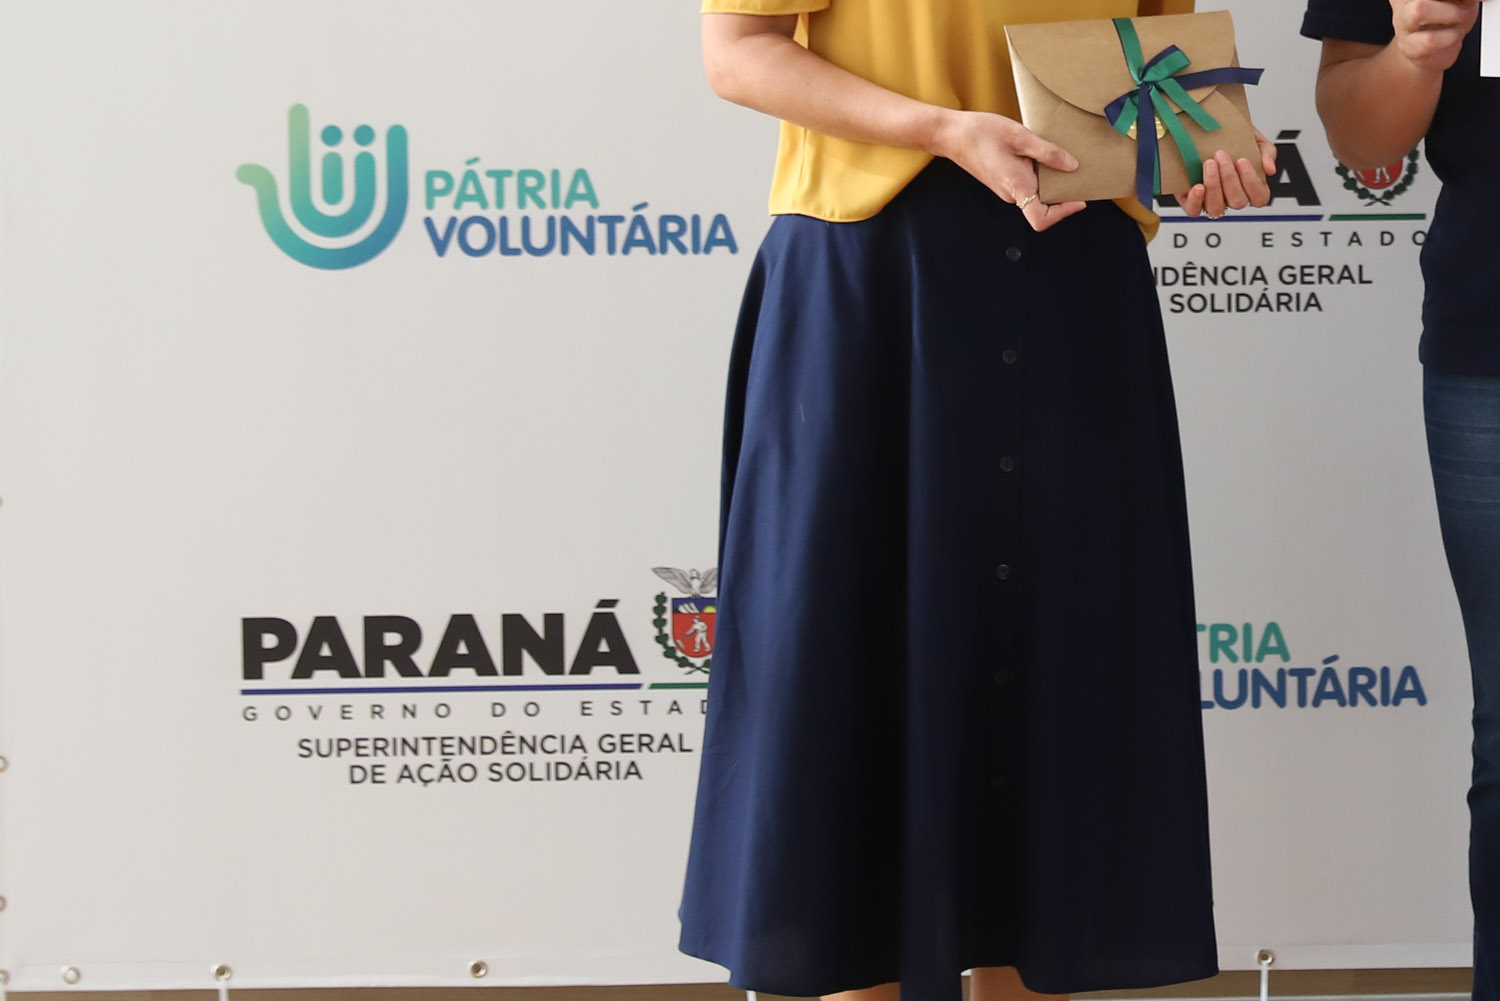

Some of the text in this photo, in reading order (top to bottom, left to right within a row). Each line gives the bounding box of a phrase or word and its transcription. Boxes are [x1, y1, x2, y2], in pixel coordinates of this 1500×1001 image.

[425, 157, 599, 210] PÁTRIA
[424, 202, 738, 257] VOLUNTÁRIA
[1173, 230, 1427, 249] DO ESTADO
[1278, 264, 1373, 286] GERAL
[1169, 287, 1323, 314] SOLIDÁRIA
[241, 599, 641, 680] PARANÁ
[242, 702, 451, 721] GOVERNO
[491, 701, 540, 718] DO
[297, 730, 694, 760] SUPERINTENDÊNCIA GERAL
[349, 755, 643, 787] DE AÇÃO SOLIDÁRIA
